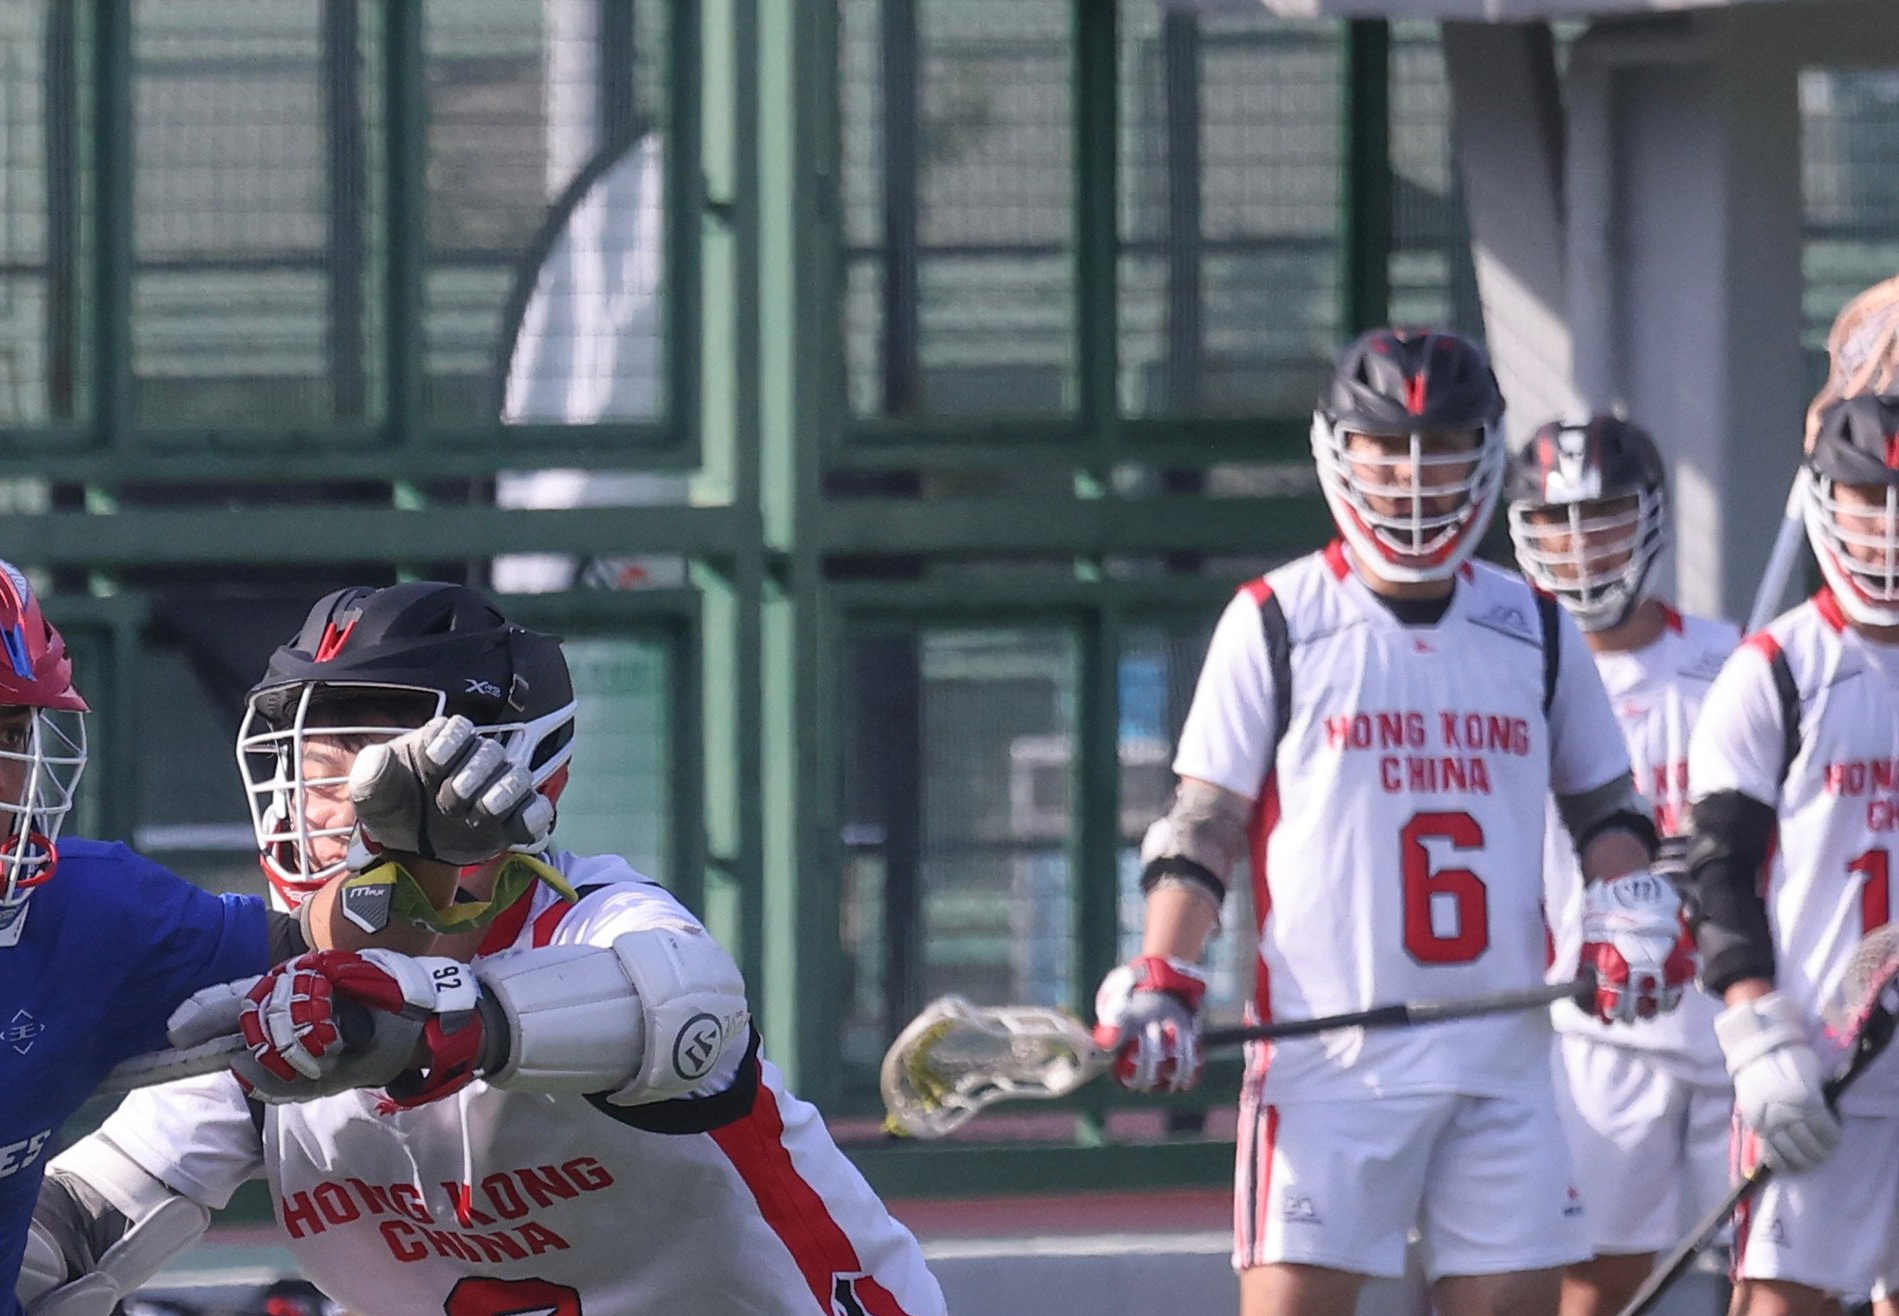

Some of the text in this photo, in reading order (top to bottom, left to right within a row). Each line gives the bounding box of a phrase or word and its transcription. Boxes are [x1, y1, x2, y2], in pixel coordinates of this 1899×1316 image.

[1324, 709, 1531, 756] HONG KONG
[1380, 756, 1491, 795] CHINA
[1401, 811, 1490, 967] 6
[432, 966, 462, 993] 92
[282, 1156, 614, 1239] HONG KONG
[379, 1220, 571, 1263] CHINA
